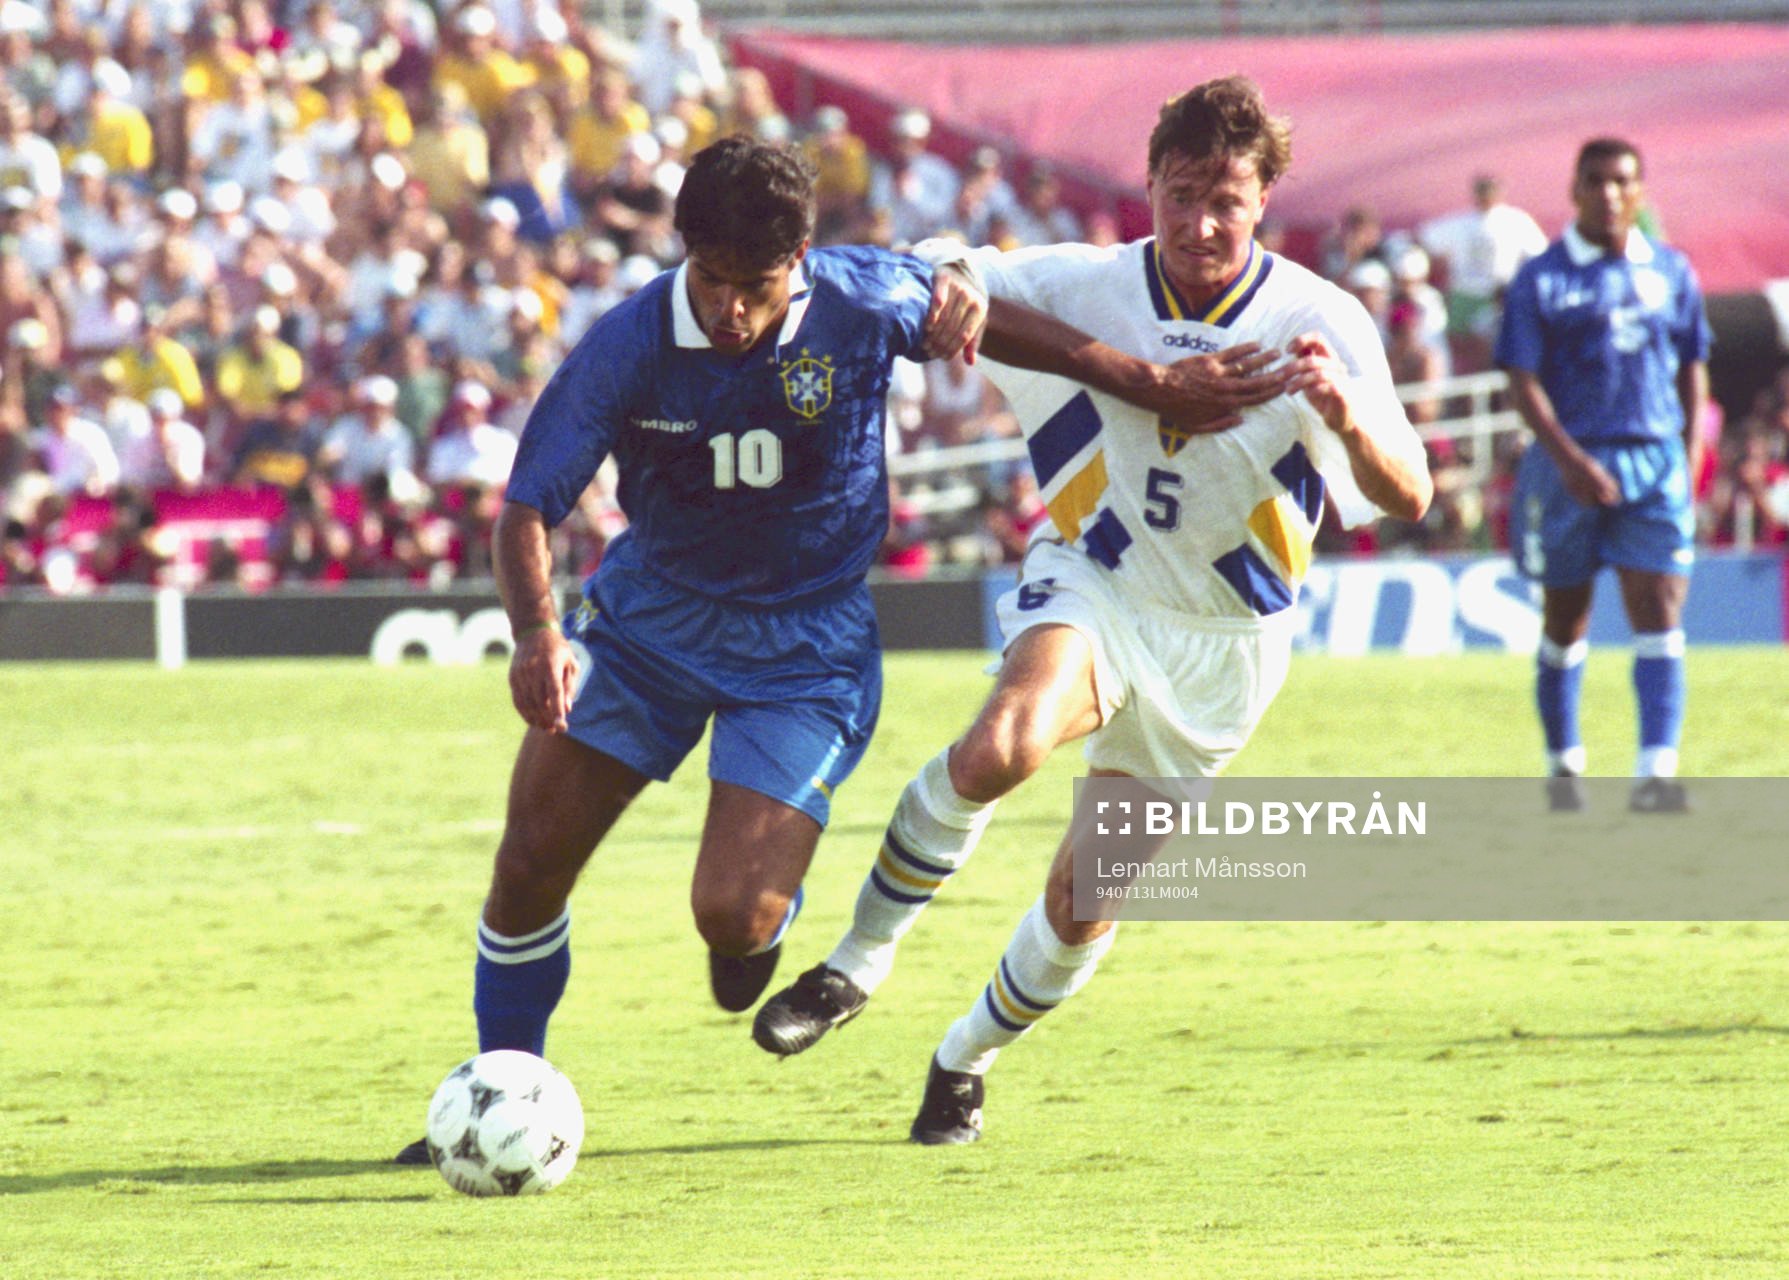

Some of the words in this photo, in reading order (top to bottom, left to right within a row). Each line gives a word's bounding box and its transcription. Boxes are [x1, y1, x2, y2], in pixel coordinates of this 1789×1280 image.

[1162, 332, 1220, 353] adidas
[708, 428, 783, 489] 10
[1143, 466, 1185, 533] 5
